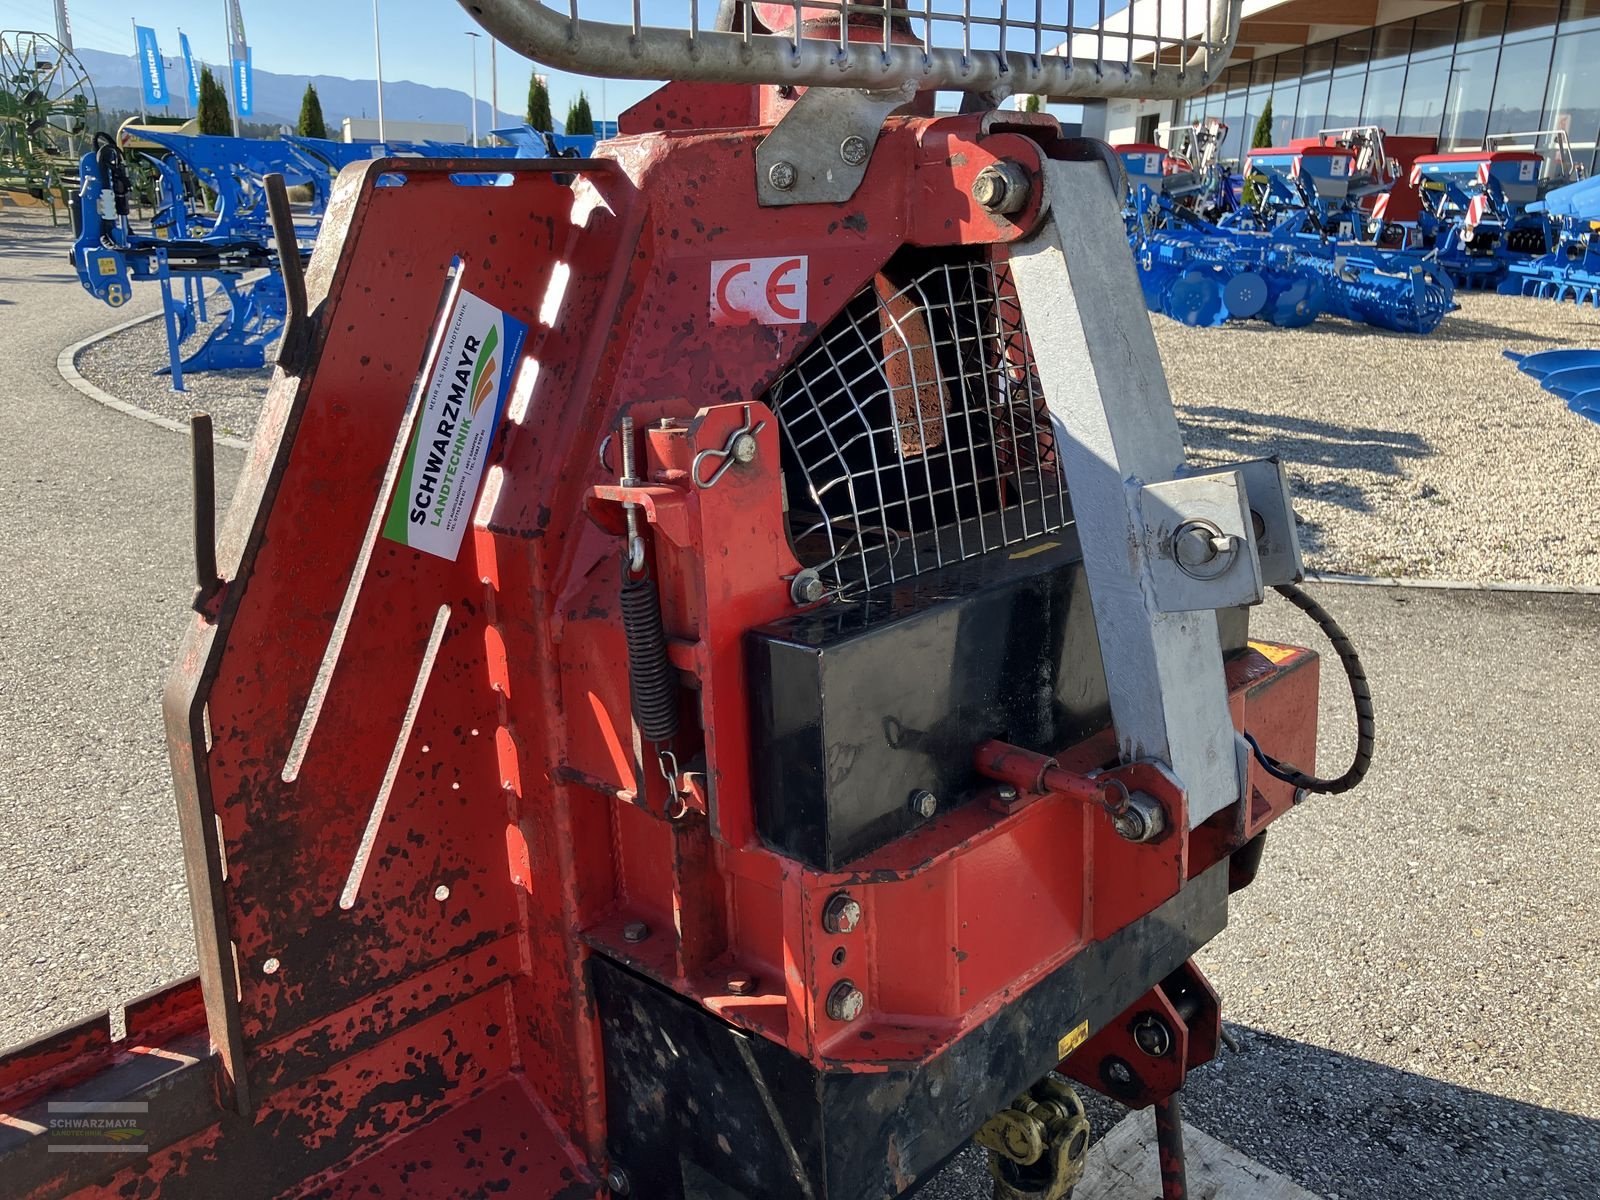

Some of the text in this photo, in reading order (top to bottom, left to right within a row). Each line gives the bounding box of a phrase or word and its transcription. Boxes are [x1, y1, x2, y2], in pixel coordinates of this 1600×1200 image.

[147, 49, 161, 90] LEMKEN
[428, 303, 467, 410] MEHR ALS NUR LANDTECHNIK.
[410, 335, 480, 526] SCHWARZMAYR
[429, 416, 472, 527] LANDTECHNIK
